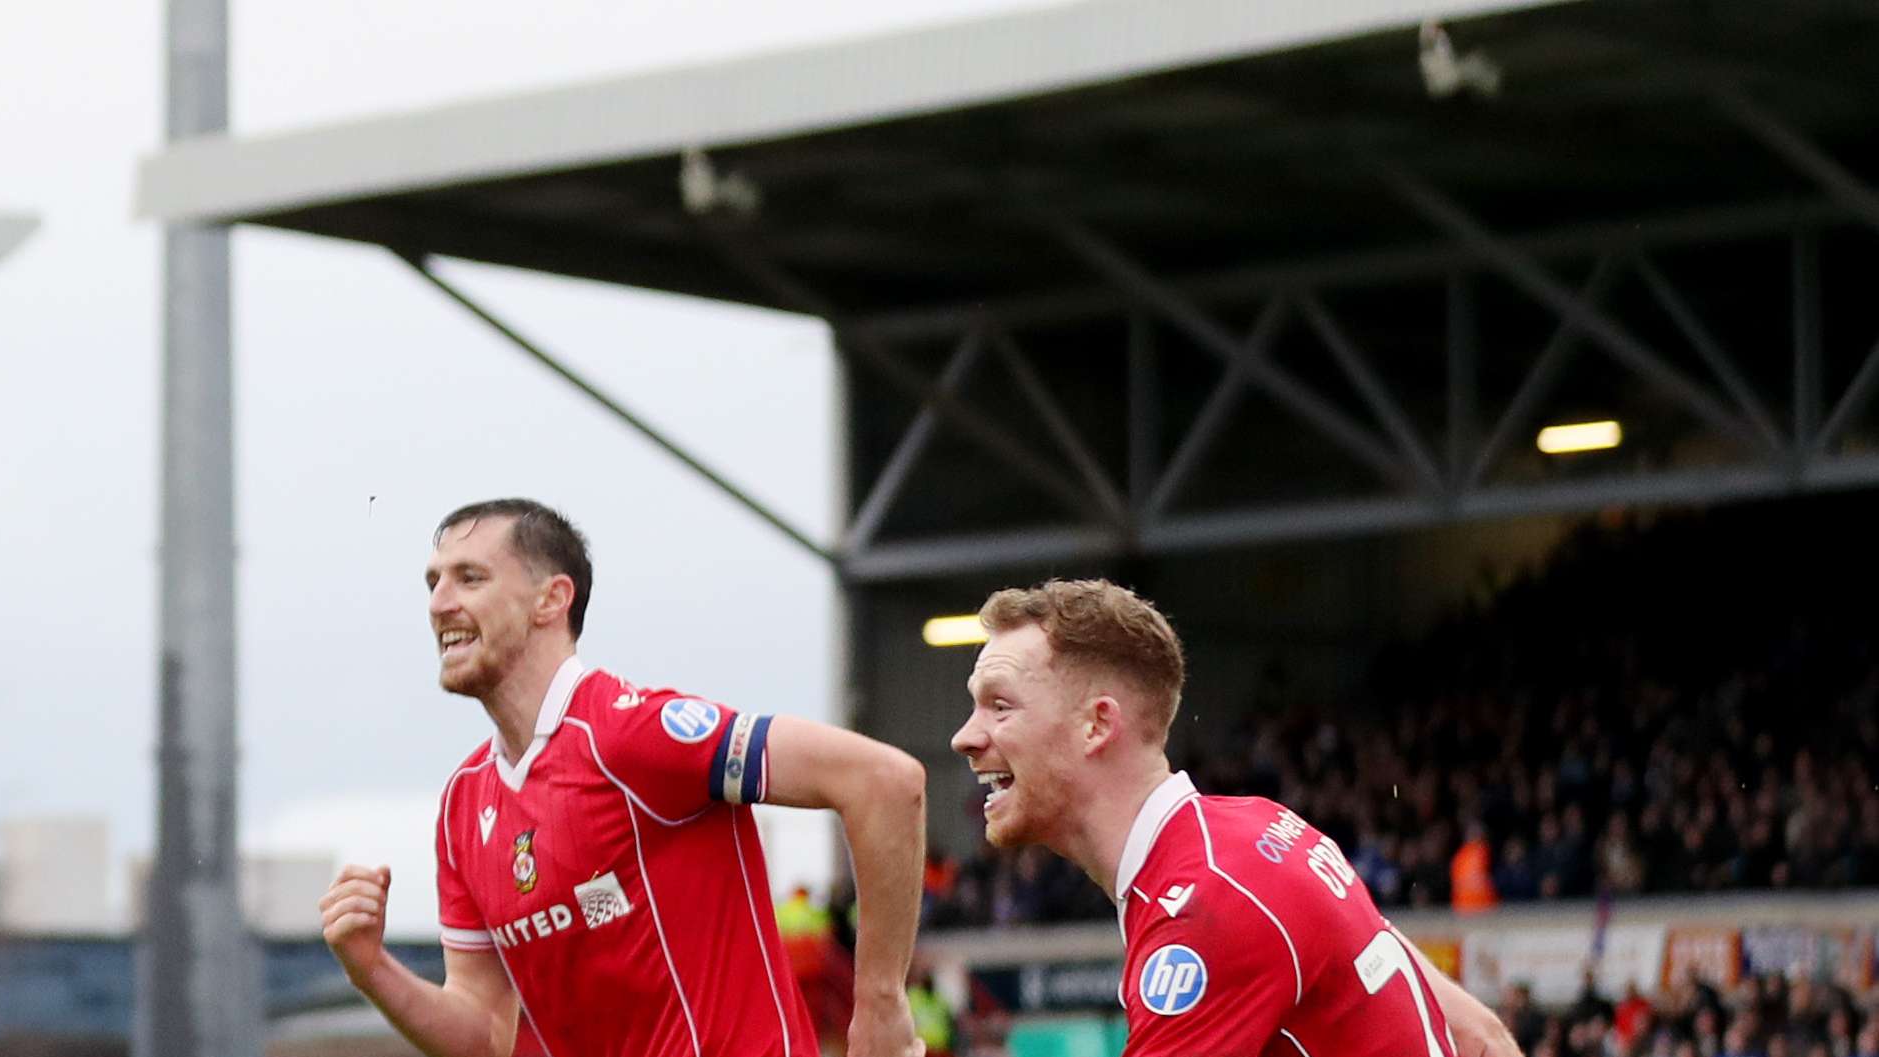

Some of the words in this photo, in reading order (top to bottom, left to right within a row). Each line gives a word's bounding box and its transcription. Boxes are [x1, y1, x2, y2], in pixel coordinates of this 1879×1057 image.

[663, 701, 715, 738] hp
[490, 903, 573, 950] NITED
[1146, 948, 1200, 1012] hp
